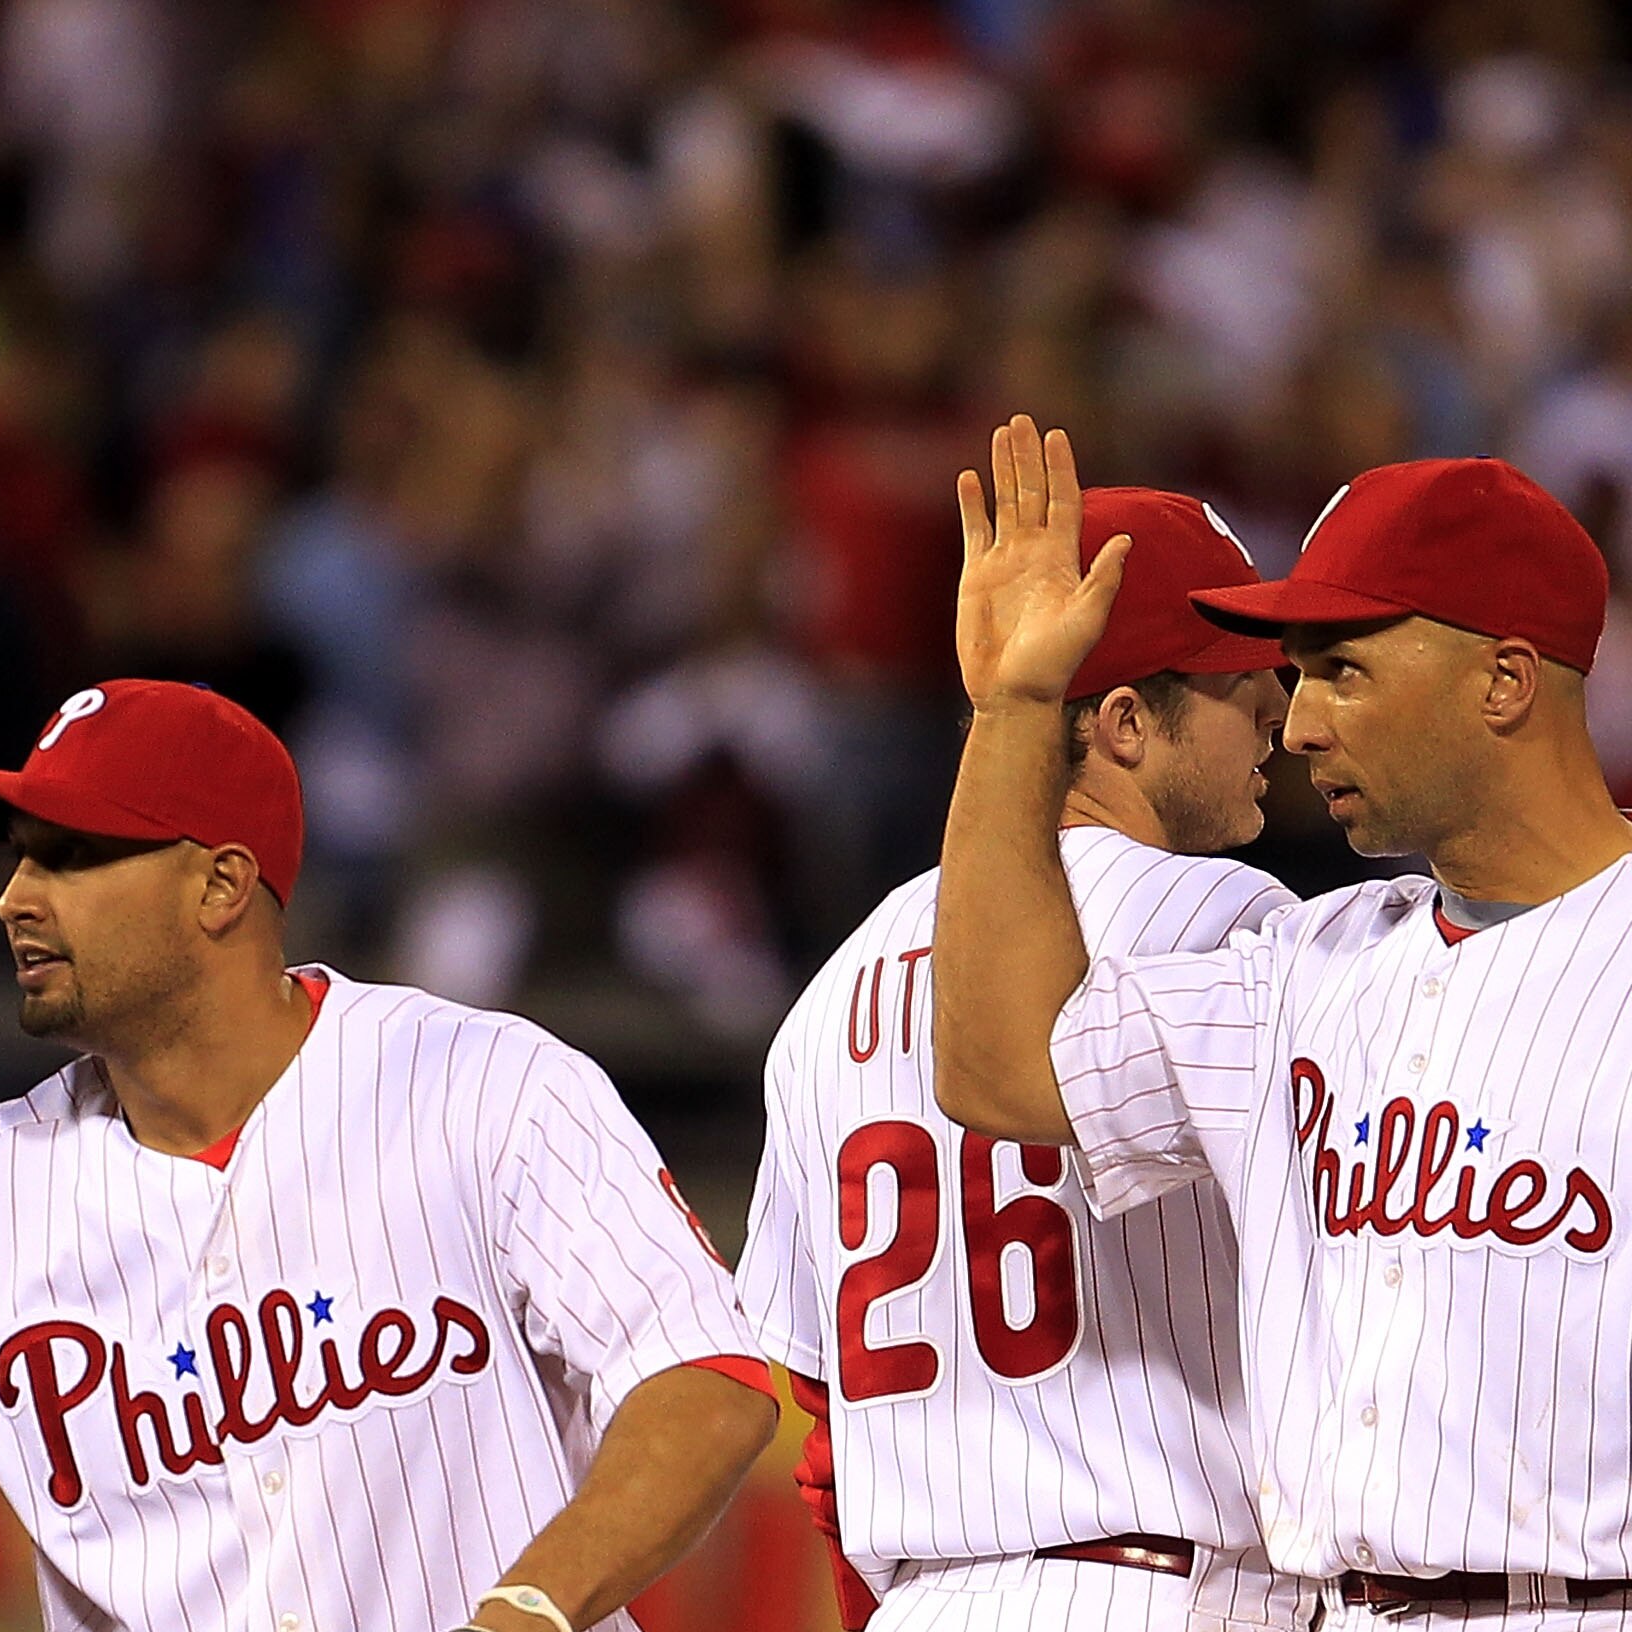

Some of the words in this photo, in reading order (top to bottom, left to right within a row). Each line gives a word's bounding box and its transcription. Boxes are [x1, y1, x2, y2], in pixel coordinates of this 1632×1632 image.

[38, 688, 106, 752] P
[849, 946, 933, 1063] UT
[1290, 1056, 1613, 1253] Phillies
[838, 1119, 1079, 1403] 26
